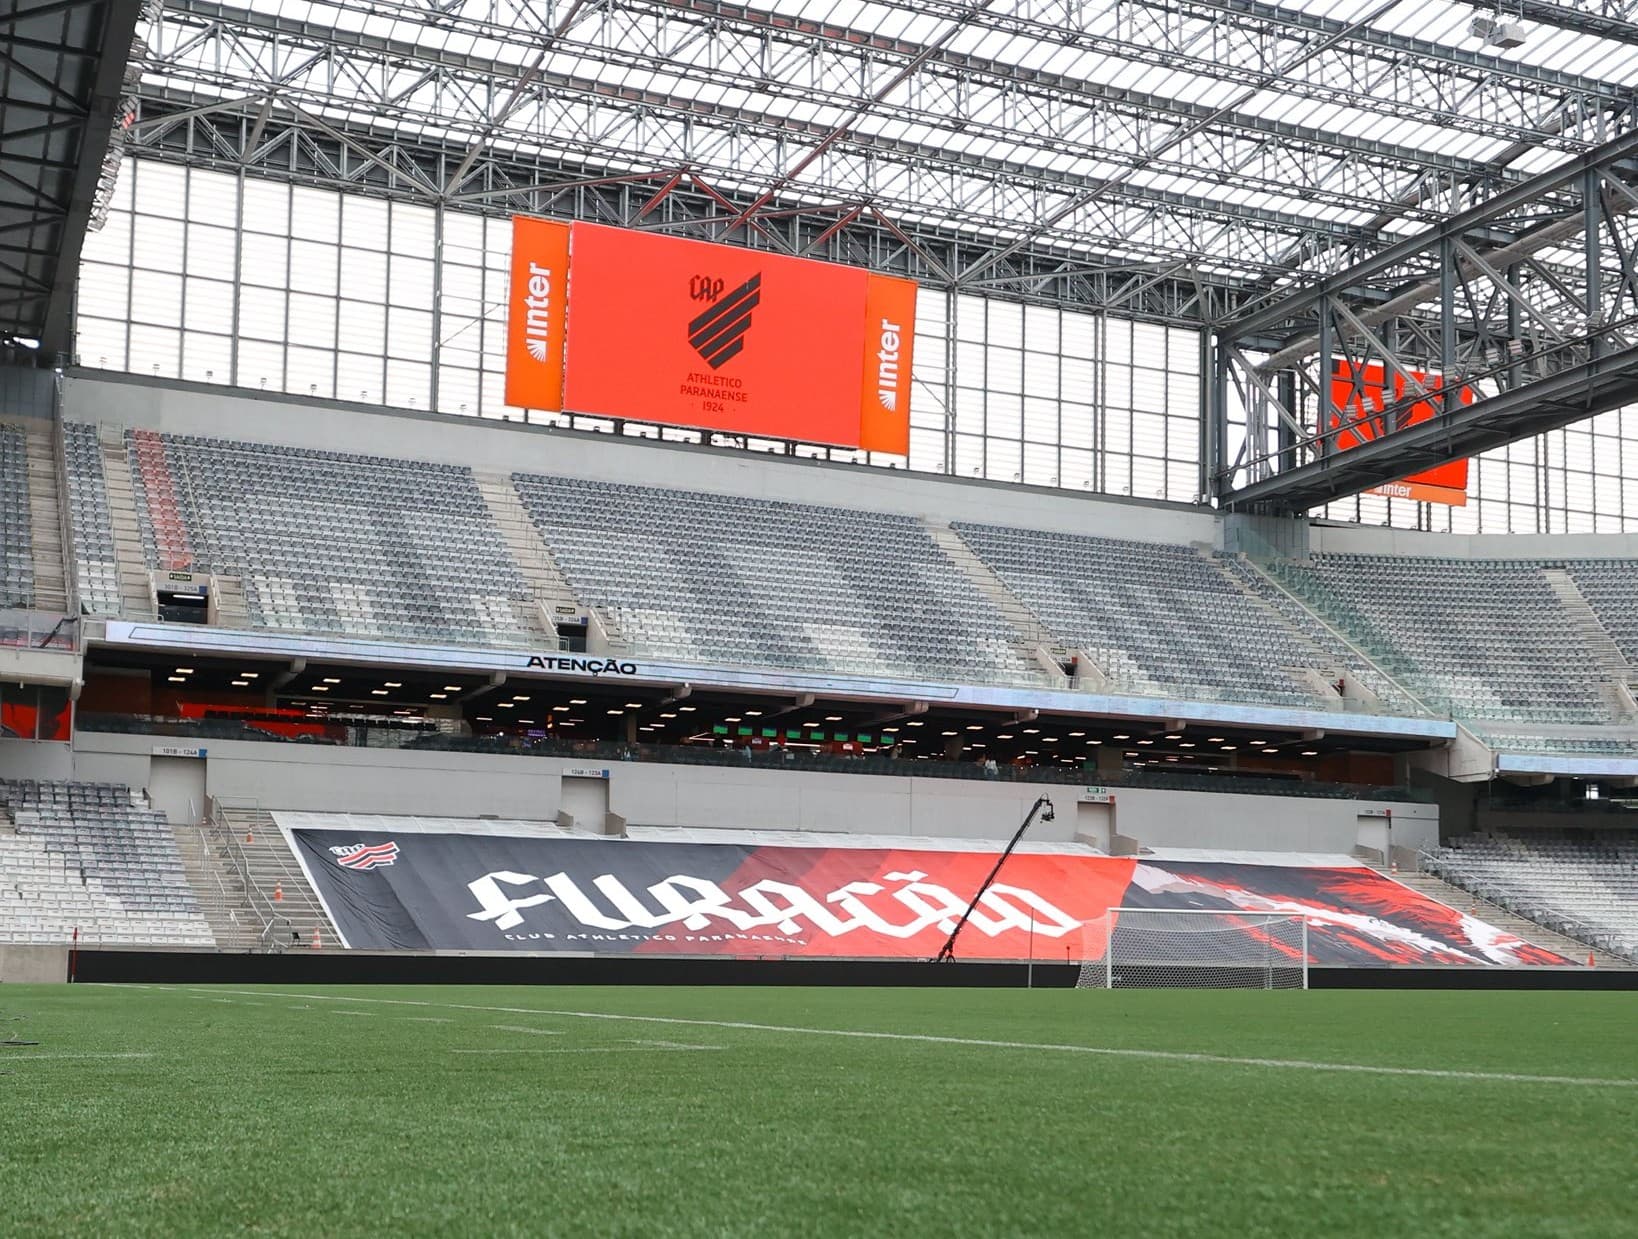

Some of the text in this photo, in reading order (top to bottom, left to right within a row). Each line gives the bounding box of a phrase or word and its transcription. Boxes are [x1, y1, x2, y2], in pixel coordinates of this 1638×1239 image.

[689, 274, 724, 302] CAP
[686, 372, 742, 389] ATHLETICO
[680, 384, 748, 402] PARANAENSE
[702, 401, 724, 413] 1924
[527, 656, 637, 677] ATENÇÃO
[504, 932, 808, 946] CLUB ATHLETICO PARANAENSE
